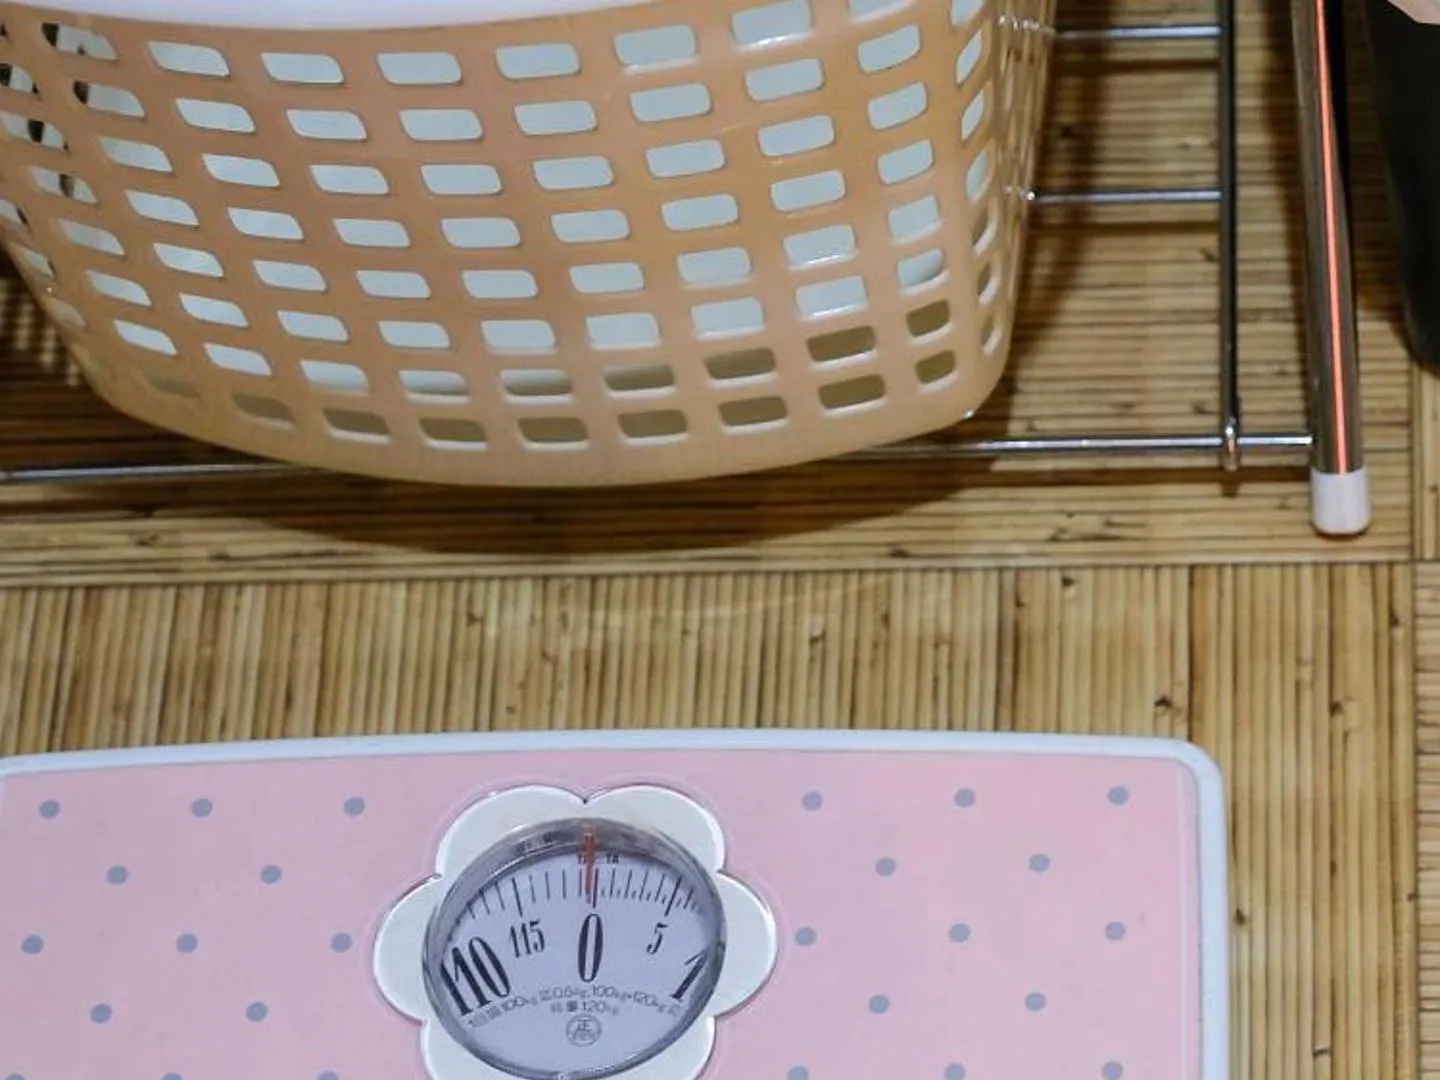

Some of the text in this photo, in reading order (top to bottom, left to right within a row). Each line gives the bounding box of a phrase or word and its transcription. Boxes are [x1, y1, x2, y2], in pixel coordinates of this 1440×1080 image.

[508, 919, 546, 958] 115
[577, 912, 603, 982] 0
[646, 922, 668, 955] 5
